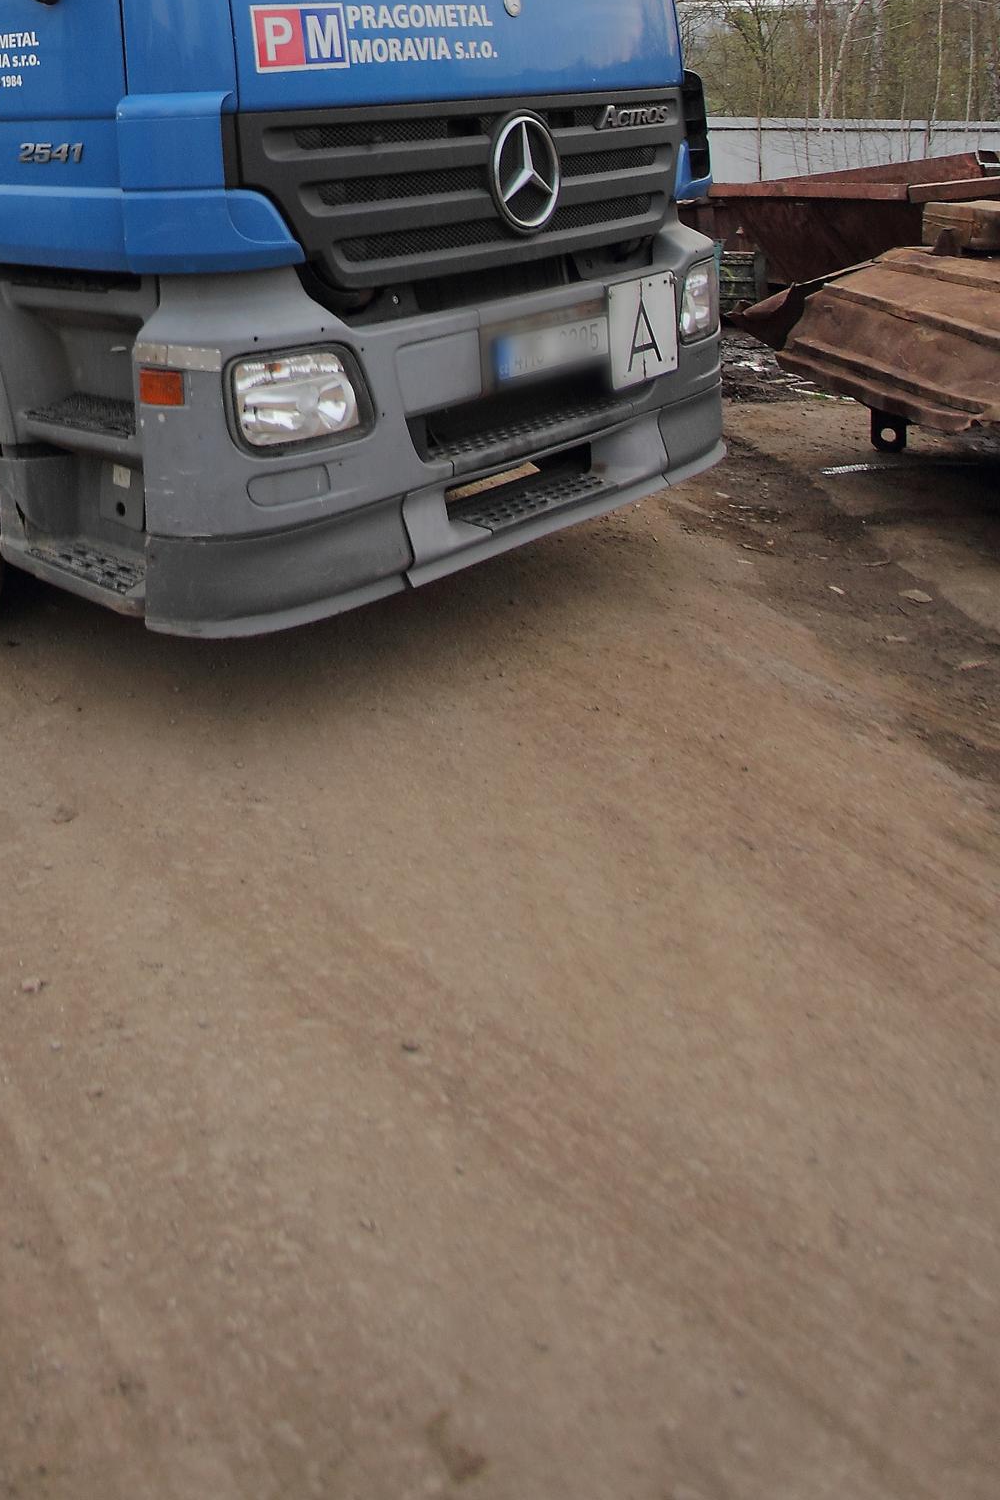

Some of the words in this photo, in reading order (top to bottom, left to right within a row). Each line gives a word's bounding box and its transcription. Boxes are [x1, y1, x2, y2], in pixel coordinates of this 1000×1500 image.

[348, 4, 493, 30] PRAGOMETAL
[264, 14, 342, 61] PM
[350, 37, 451, 64] MORAVIA
[455, 41, 498, 60] s.r.o.
[12, 54, 41, 67] s.r.o.
[19, 141, 83, 164] 2541
[627, 298, 663, 373] A
